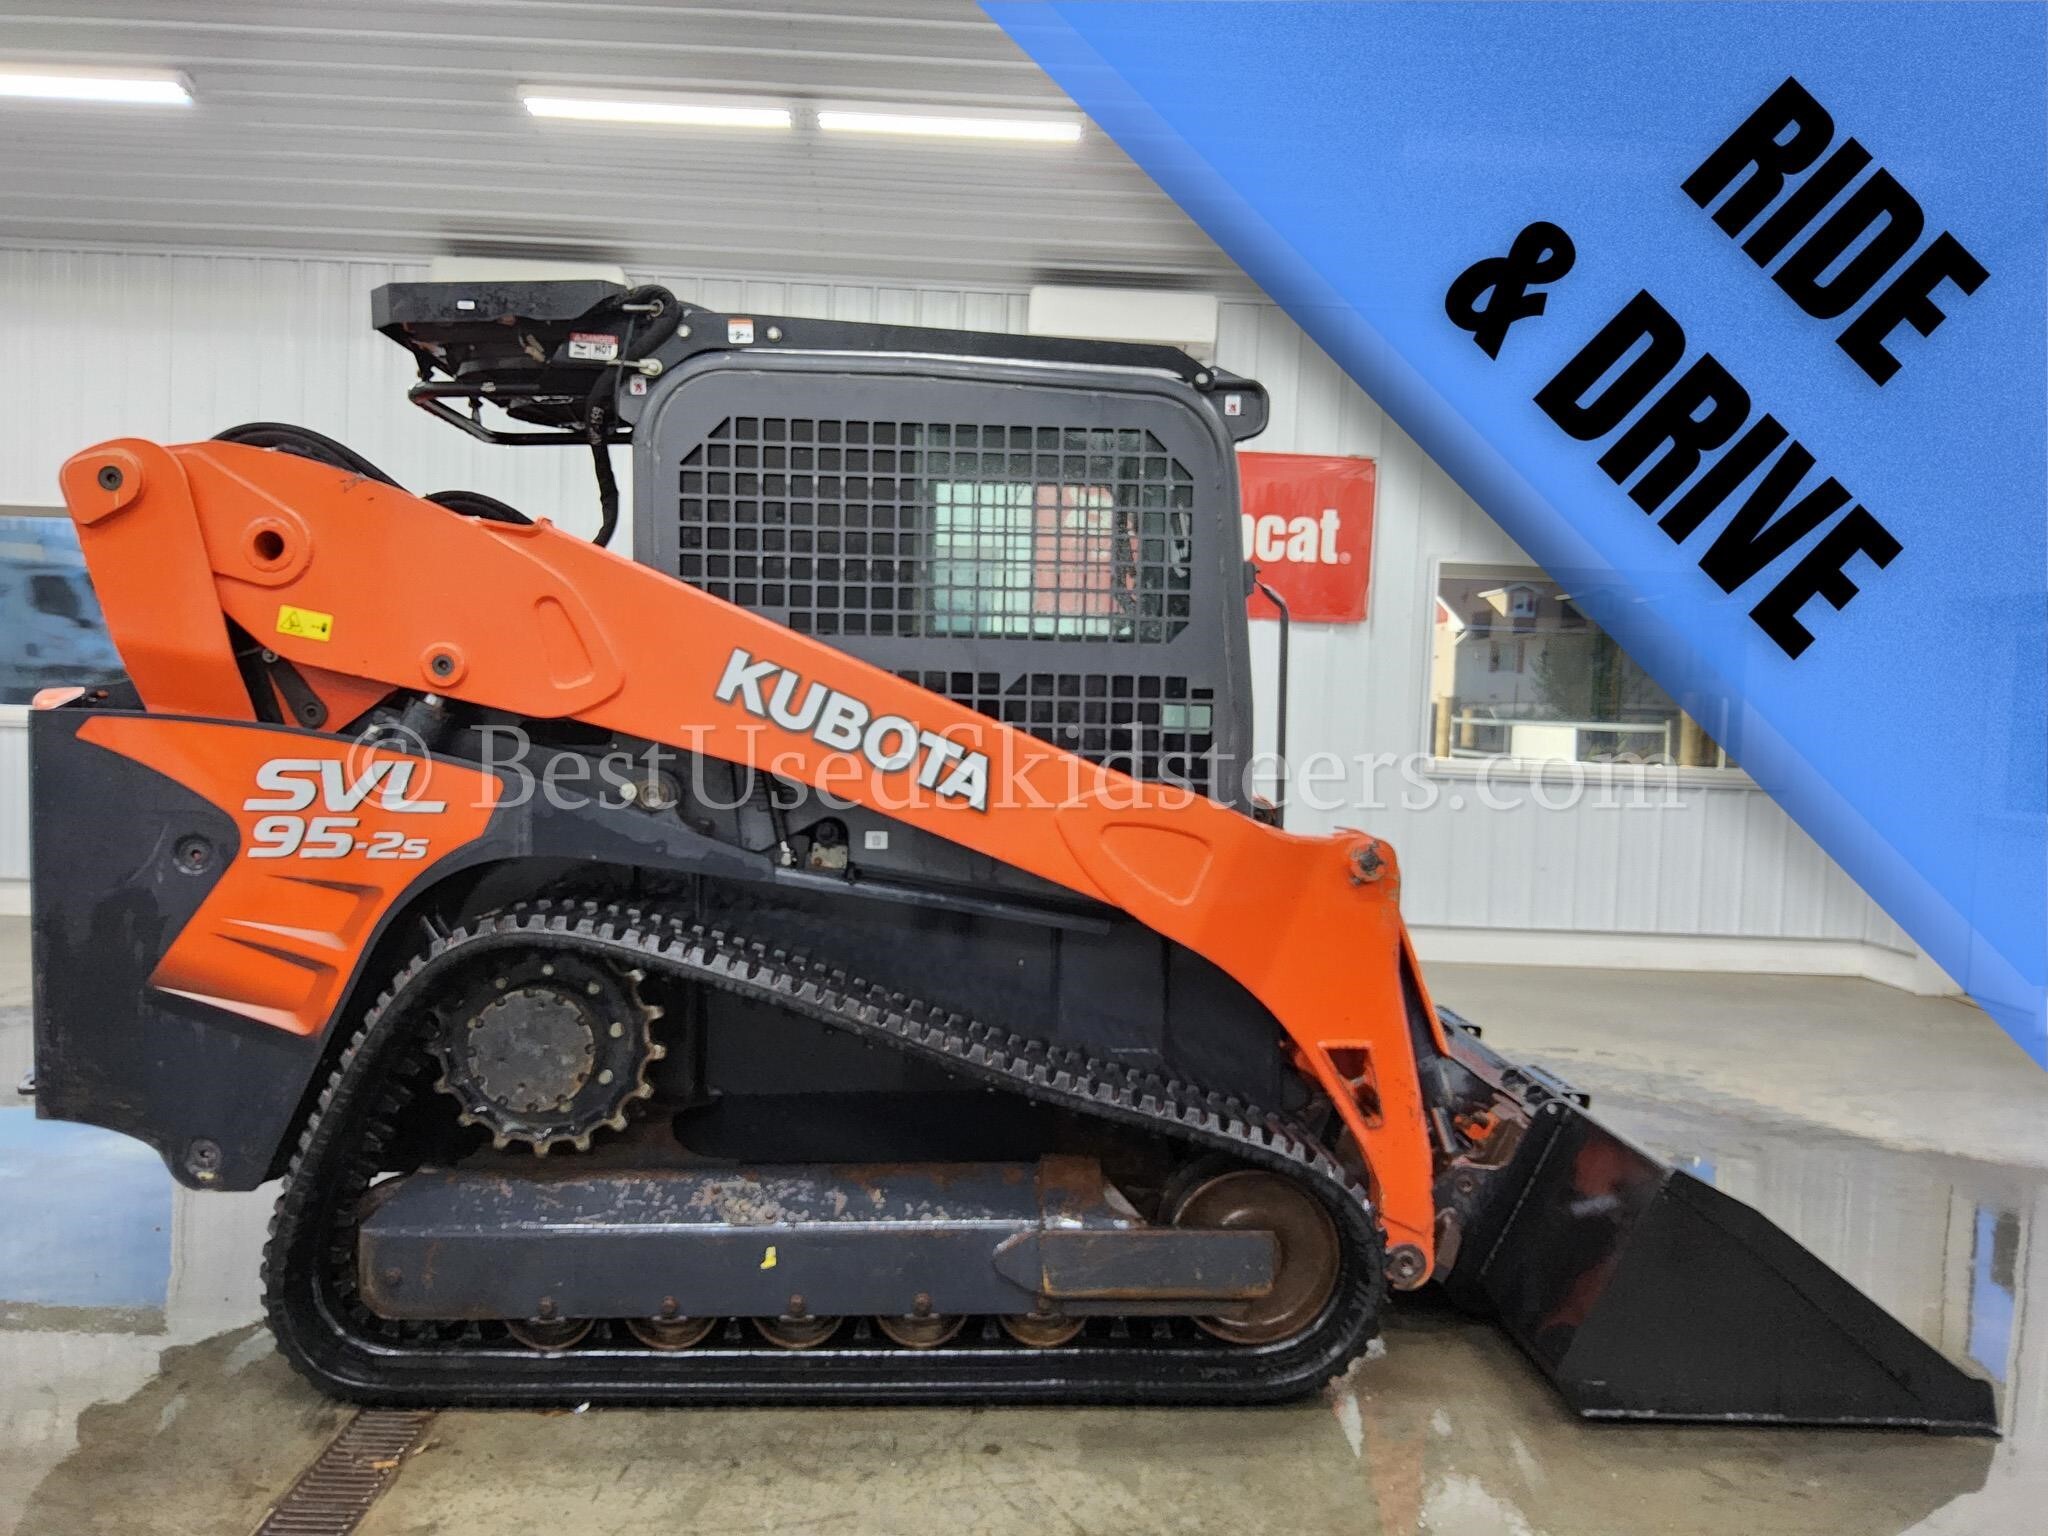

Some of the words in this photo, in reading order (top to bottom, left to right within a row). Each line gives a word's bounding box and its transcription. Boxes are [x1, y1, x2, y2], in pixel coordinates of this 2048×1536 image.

[595, 343, 612, 355] HOT
[715, 647, 989, 812] KUBOTA
[242, 758, 448, 813] SVL
